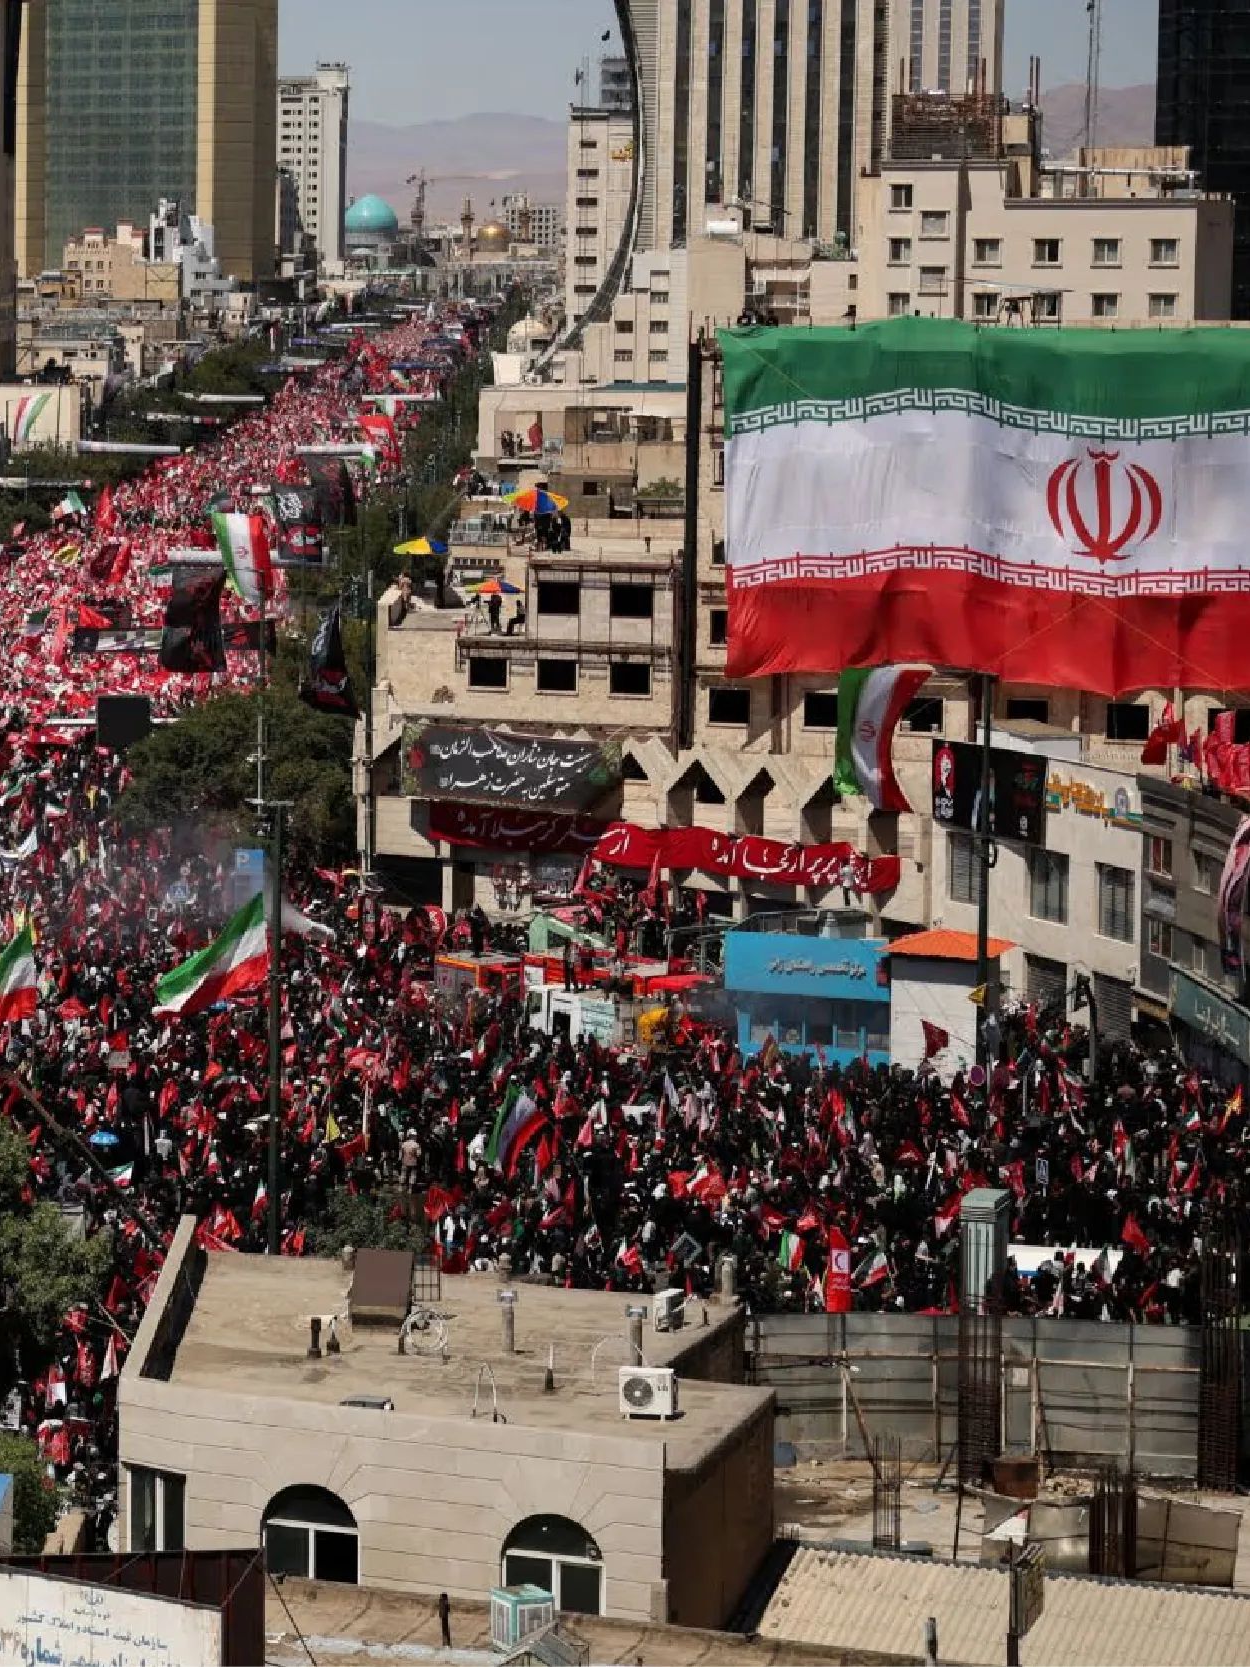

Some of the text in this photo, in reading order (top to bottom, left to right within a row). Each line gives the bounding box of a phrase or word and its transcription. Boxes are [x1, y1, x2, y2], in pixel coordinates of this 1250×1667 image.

[491, 771, 525, 796] حضرت
[236, 852, 250, 870] P
[711, 836, 743, 864] آمده
[806, 855, 838, 886] پرپر
